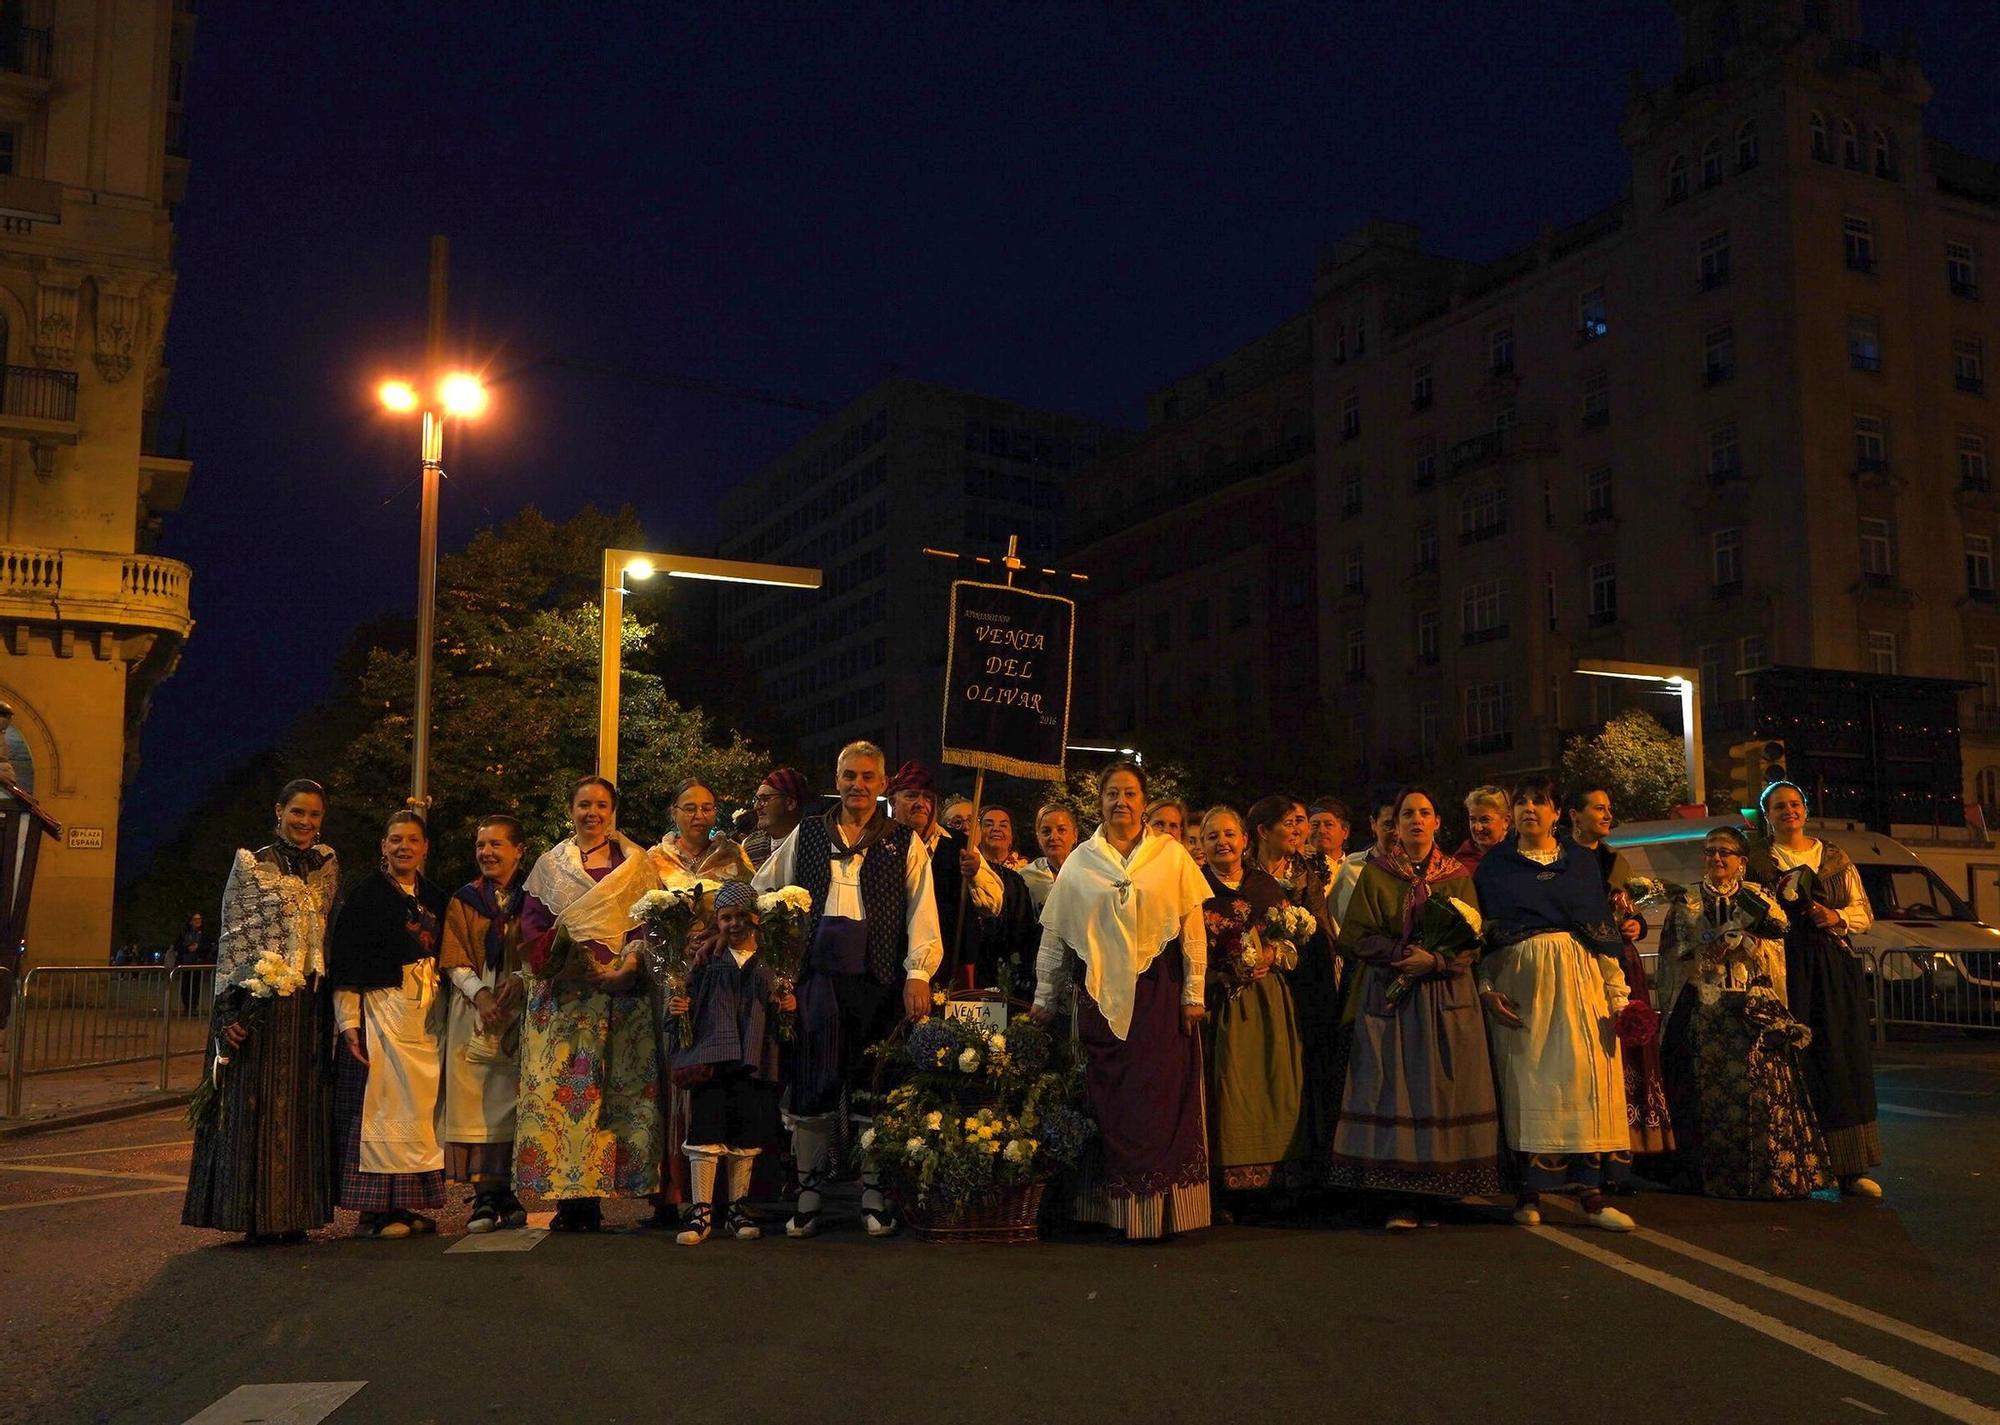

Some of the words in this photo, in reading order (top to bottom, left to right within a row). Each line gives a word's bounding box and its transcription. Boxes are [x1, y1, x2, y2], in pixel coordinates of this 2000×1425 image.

[976, 625, 1045, 650] VENTA
[986, 656, 1032, 678] DEL
[966, 684, 1043, 714] OLIVAR
[1040, 715, 1057, 726] 2016
[71, 838, 100, 846] ESPAÑA
[954, 1004, 990, 1018] VENTA
